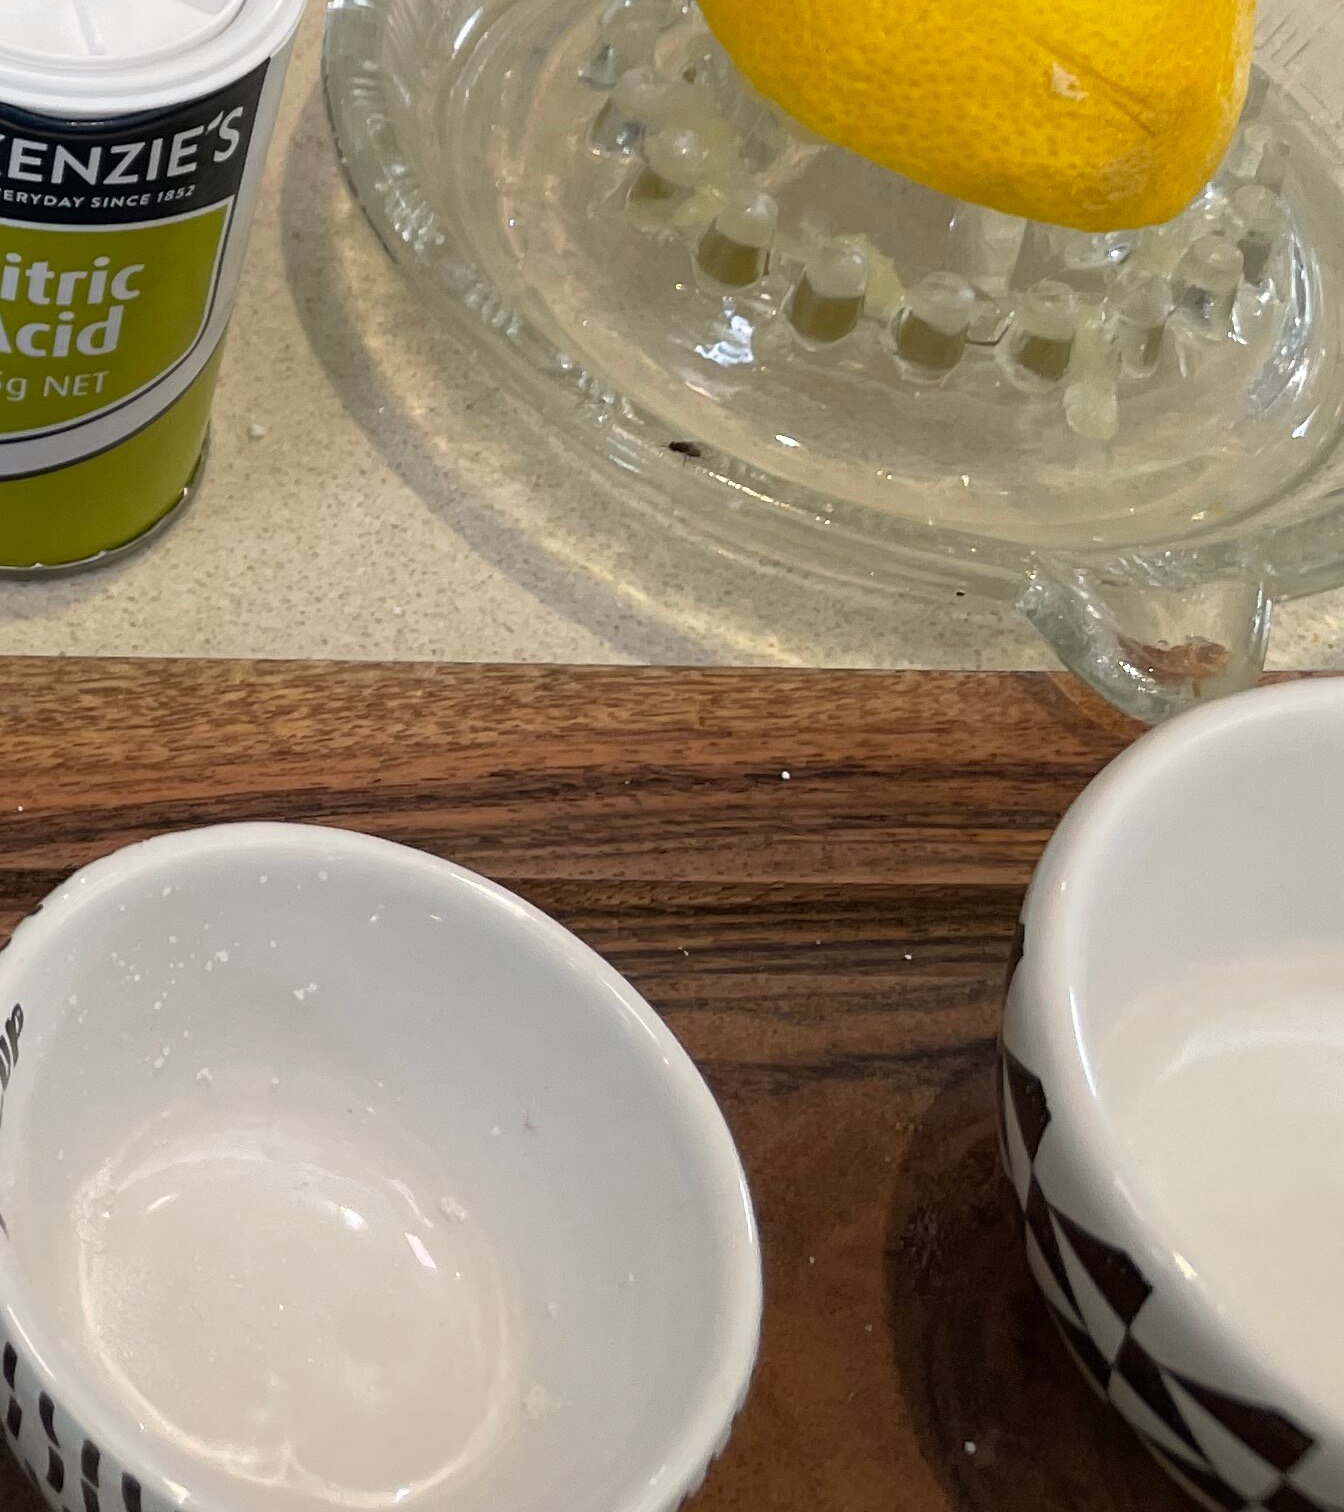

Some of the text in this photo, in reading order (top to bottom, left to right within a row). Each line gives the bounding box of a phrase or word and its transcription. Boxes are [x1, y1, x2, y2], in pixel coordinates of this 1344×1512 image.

[90, 192, 152, 209] SINCE
[156, 184, 197, 204] 1852
[42, 371, 110, 399] NET
